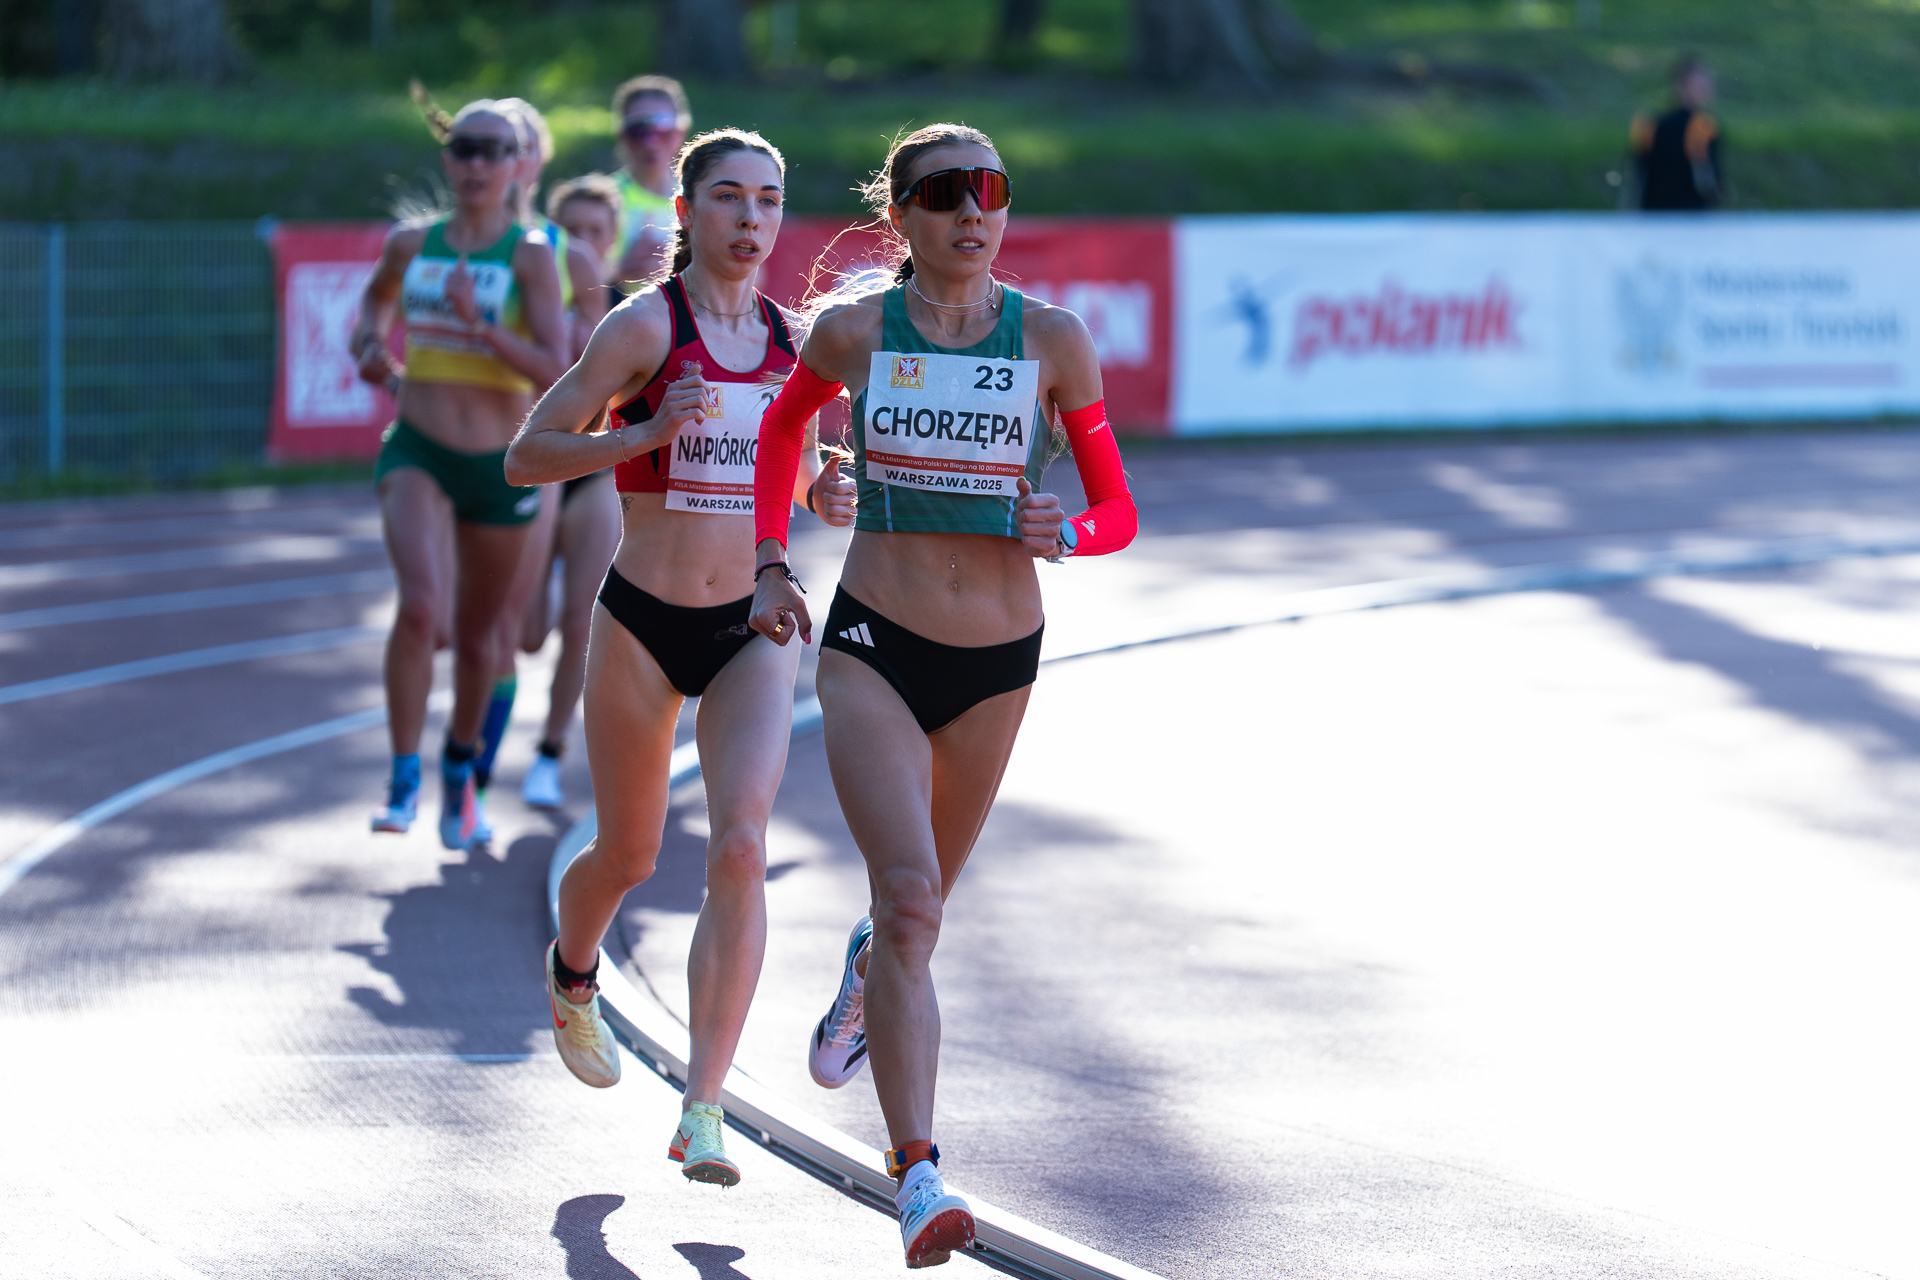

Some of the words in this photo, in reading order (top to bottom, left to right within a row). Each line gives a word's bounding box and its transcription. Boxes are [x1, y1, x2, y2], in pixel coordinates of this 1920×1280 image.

[892, 377, 922, 387] PZLA
[974, 365, 1014, 391] 23
[704, 407, 722, 417] ZLA
[872, 406, 1023, 449] CHORZĘPA
[677, 431, 758, 466] NAPIÓRKO
[872, 453, 885, 461] PZLA
[886, 456, 922, 466] Mistrzostwa
[924, 460, 941, 468] Polski
[950, 462, 967, 471] Biegu
[996, 466, 1019, 474] metrów
[689, 483, 721, 491] Mistrzostwa
[885, 469, 970, 489] WARSZAWA
[973, 478, 1002, 490] 2025
[686, 497, 754, 510] WARSZAW
